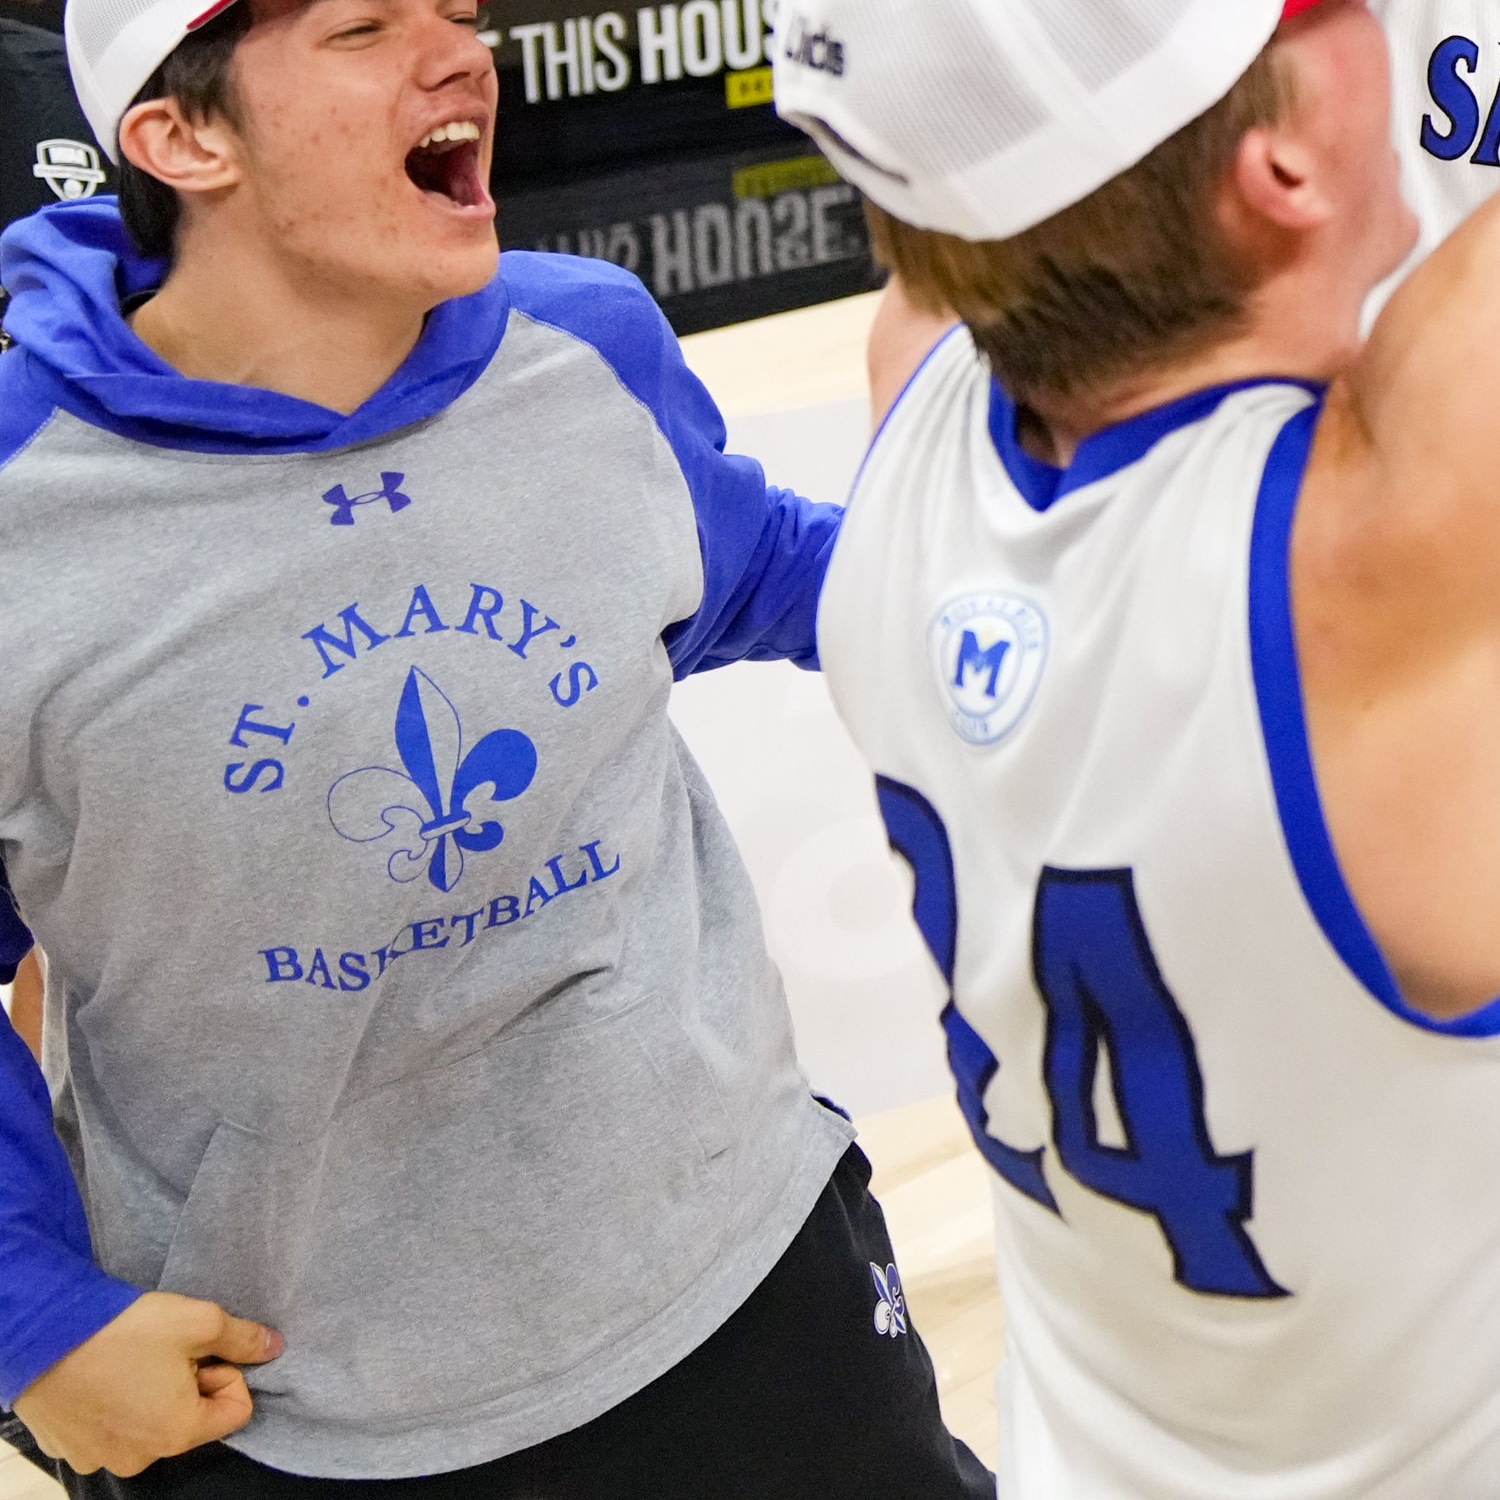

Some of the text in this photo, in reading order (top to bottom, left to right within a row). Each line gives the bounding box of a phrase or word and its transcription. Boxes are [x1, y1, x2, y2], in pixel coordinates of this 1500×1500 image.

[509, 11, 632, 105] THIS
[223, 583, 599, 793] ST. MARY'S
[954, 629, 1011, 697] M
[259, 840, 621, 991] BASKETBALL
[874, 772, 1295, 1300] 24
